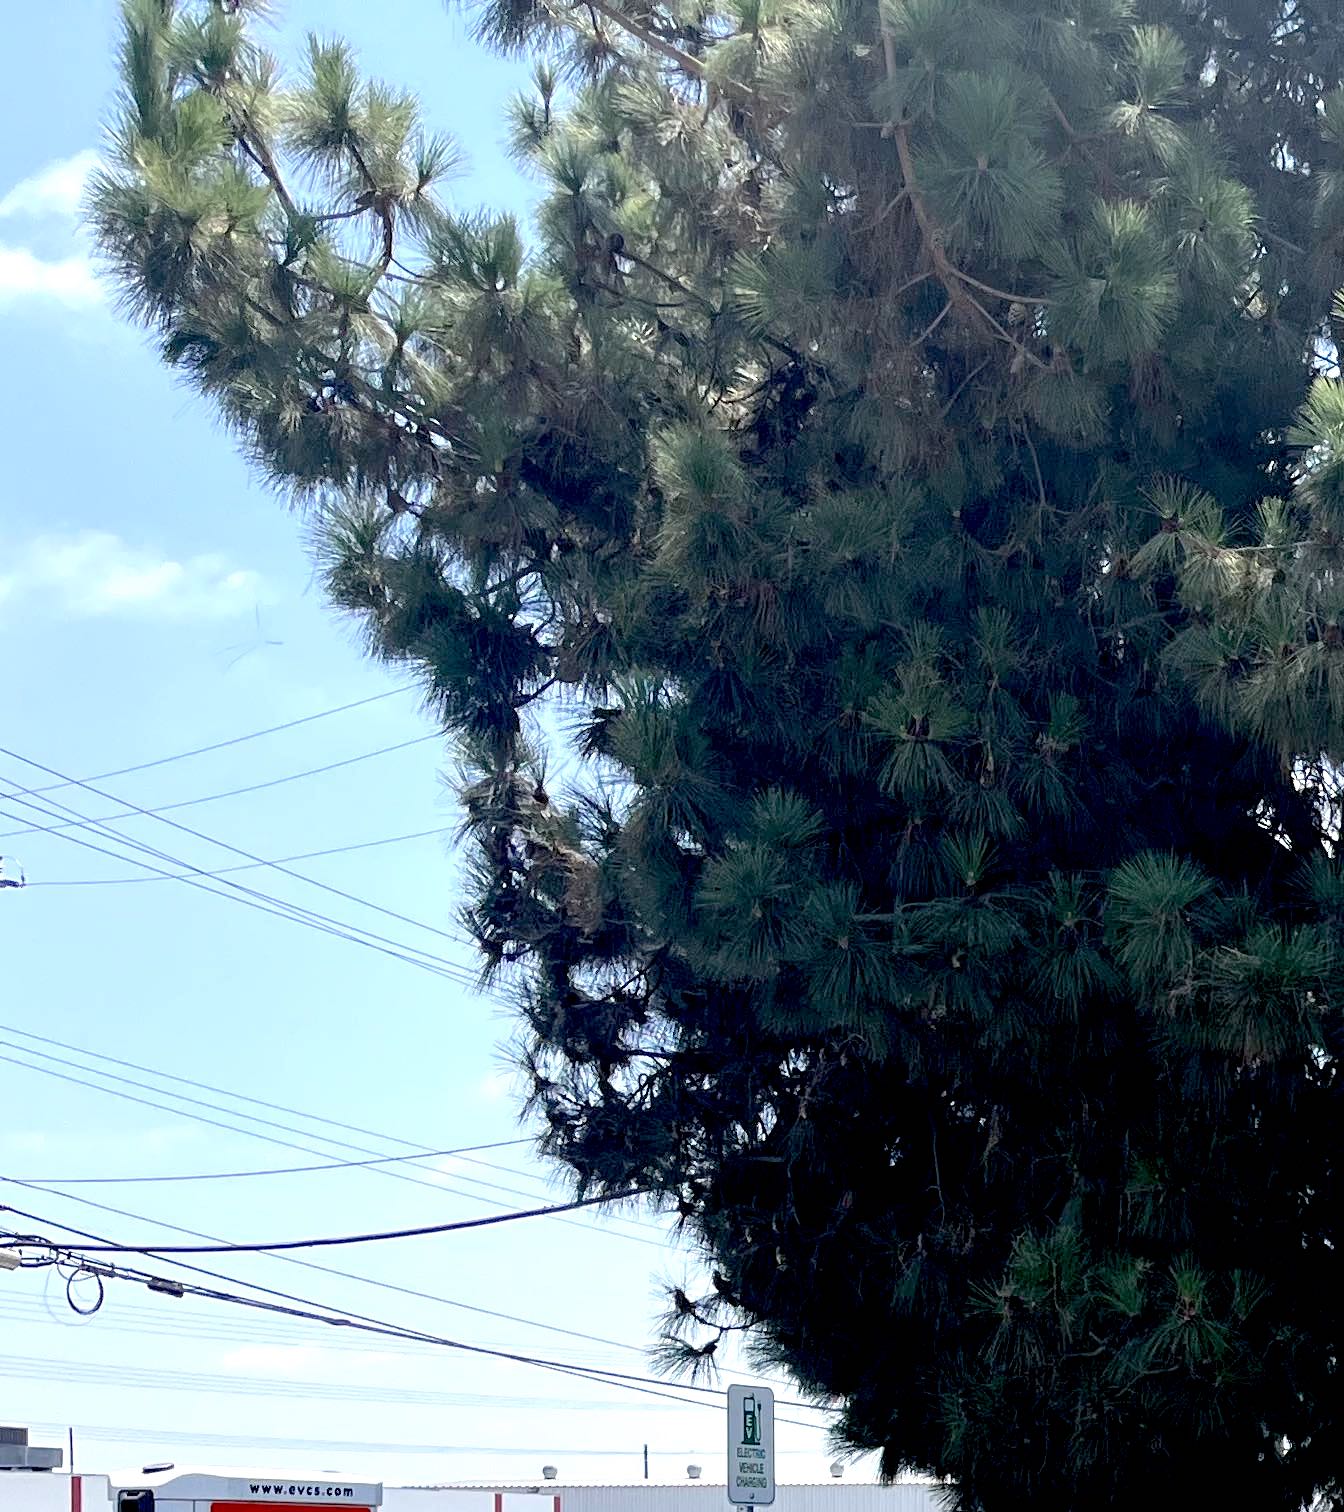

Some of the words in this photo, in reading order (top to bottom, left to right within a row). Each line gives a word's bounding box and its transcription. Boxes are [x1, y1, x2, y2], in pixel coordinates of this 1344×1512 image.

[746, 1414, 753, 1439] EV
[736, 1447, 766, 1459] ELECTRIC
[739, 1461, 764, 1474] VEHICLE
[736, 1475, 767, 1488] CHARGING
[250, 1484, 353, 1497] www.evcs.com
